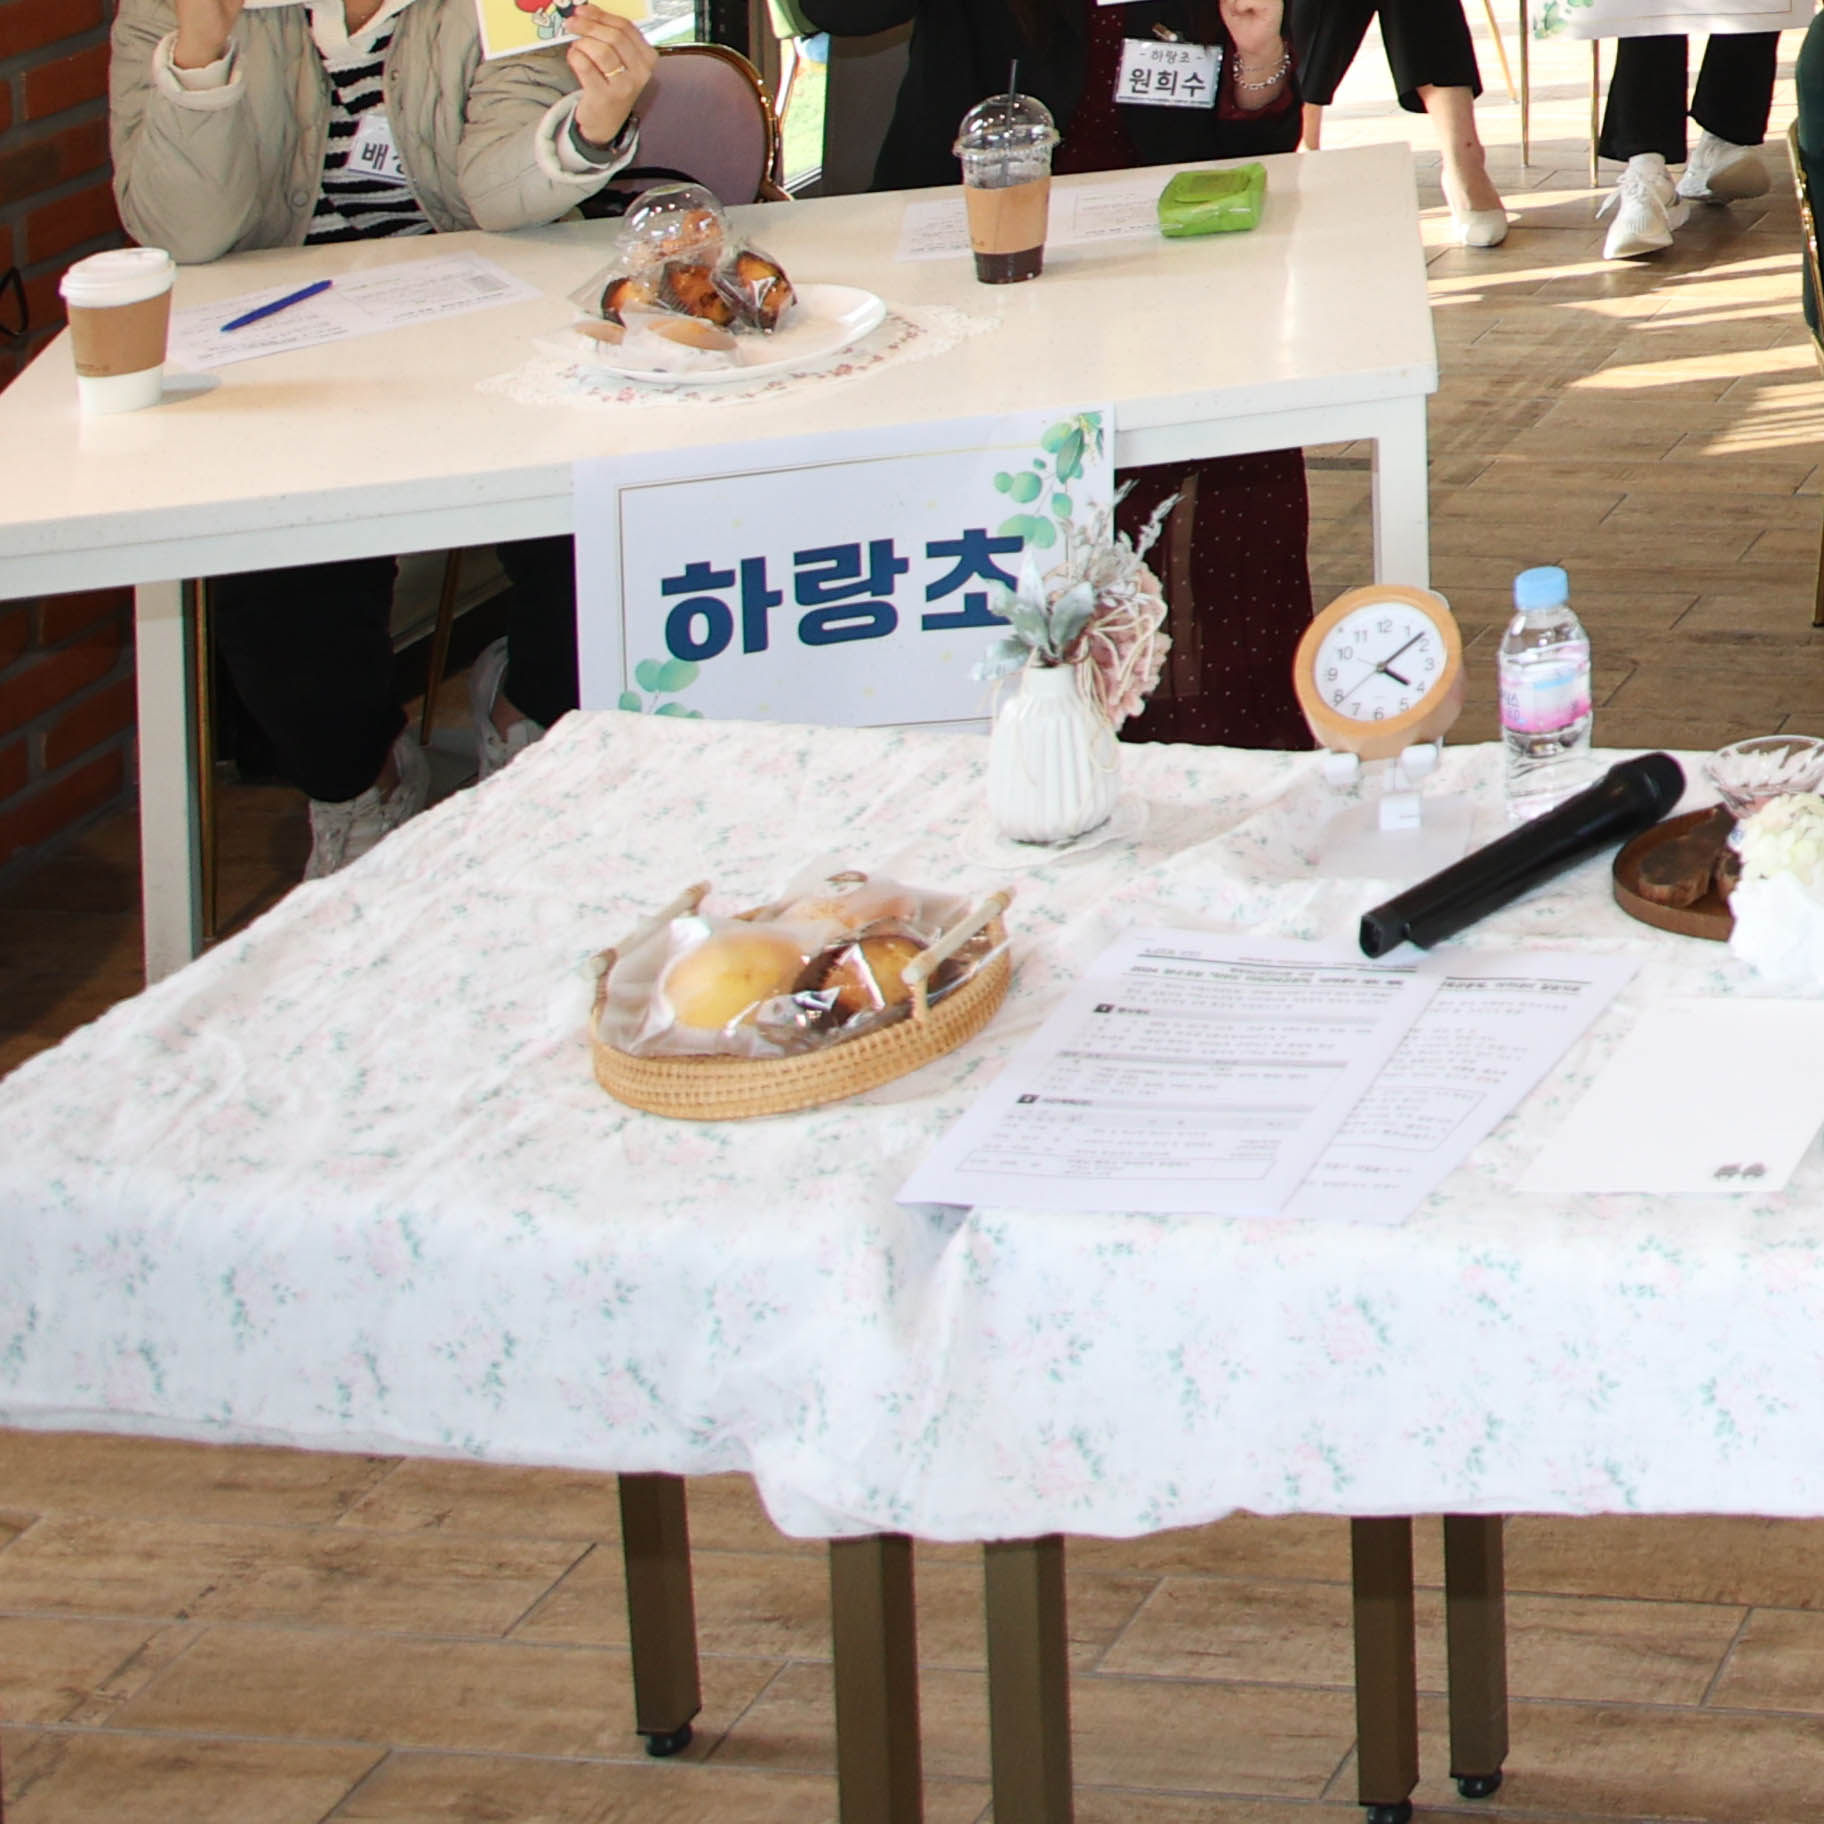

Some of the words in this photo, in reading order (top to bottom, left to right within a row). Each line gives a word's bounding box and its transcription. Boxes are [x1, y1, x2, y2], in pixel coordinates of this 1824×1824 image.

[1129, 67, 1206, 98] 원희수
[661, 528, 1025, 661] 하랑초
[1377, 619, 1393, 634] 12
[1353, 629, 1368, 644] 11
[1337, 646, 1353, 661] 10
[1424, 657, 1436, 672] 3
[1327, 667, 1339, 682] 9
[1416, 680, 1426, 693] 4
[1351, 701, 1361, 716] 7
[1399, 696, 1410, 712] 5
[1374, 706, 1385, 721] 6
